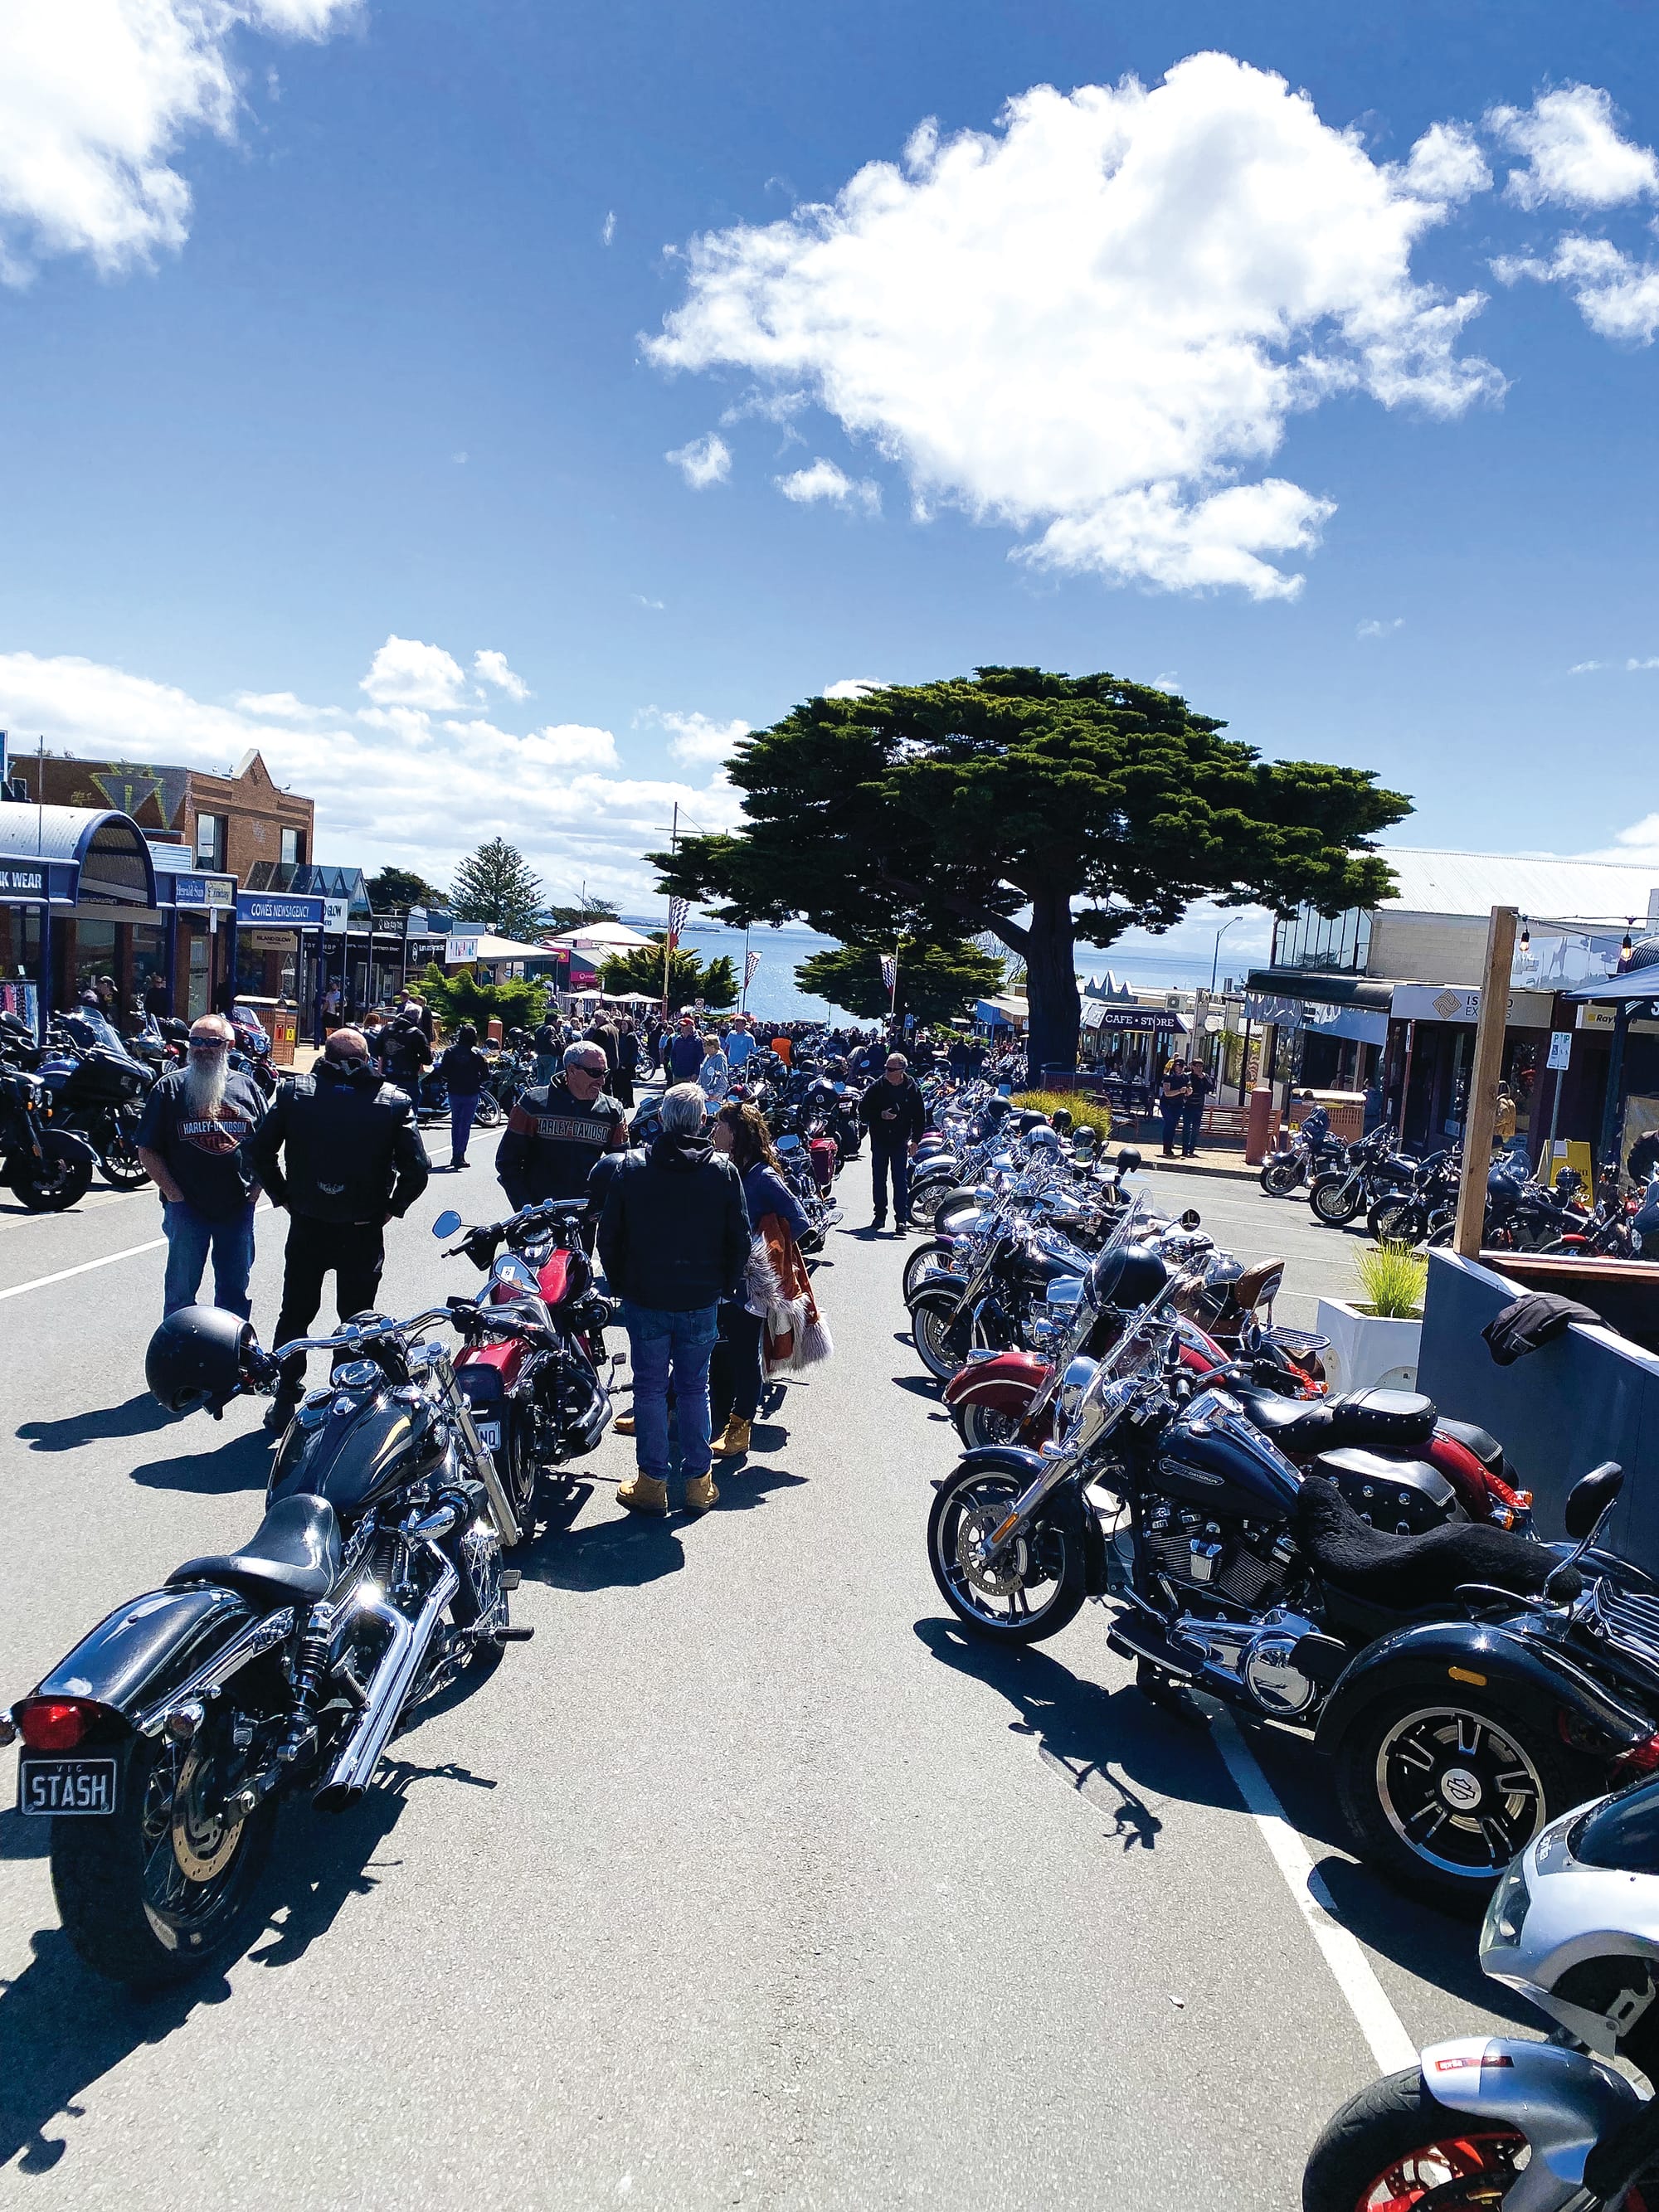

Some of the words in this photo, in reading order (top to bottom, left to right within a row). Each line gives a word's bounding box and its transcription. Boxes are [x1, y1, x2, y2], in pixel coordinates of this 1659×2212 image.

[12, 872, 42, 888] WEAR
[251, 903, 272, 916] COWES
[273, 905, 309, 918] NEWSAGENCY
[1105, 1014, 1133, 1024] CAFE
[1141, 1017, 1175, 1027] STORE
[56, 1764, 83, 1772] VIC
[32, 1775, 106, 1806] STASH
